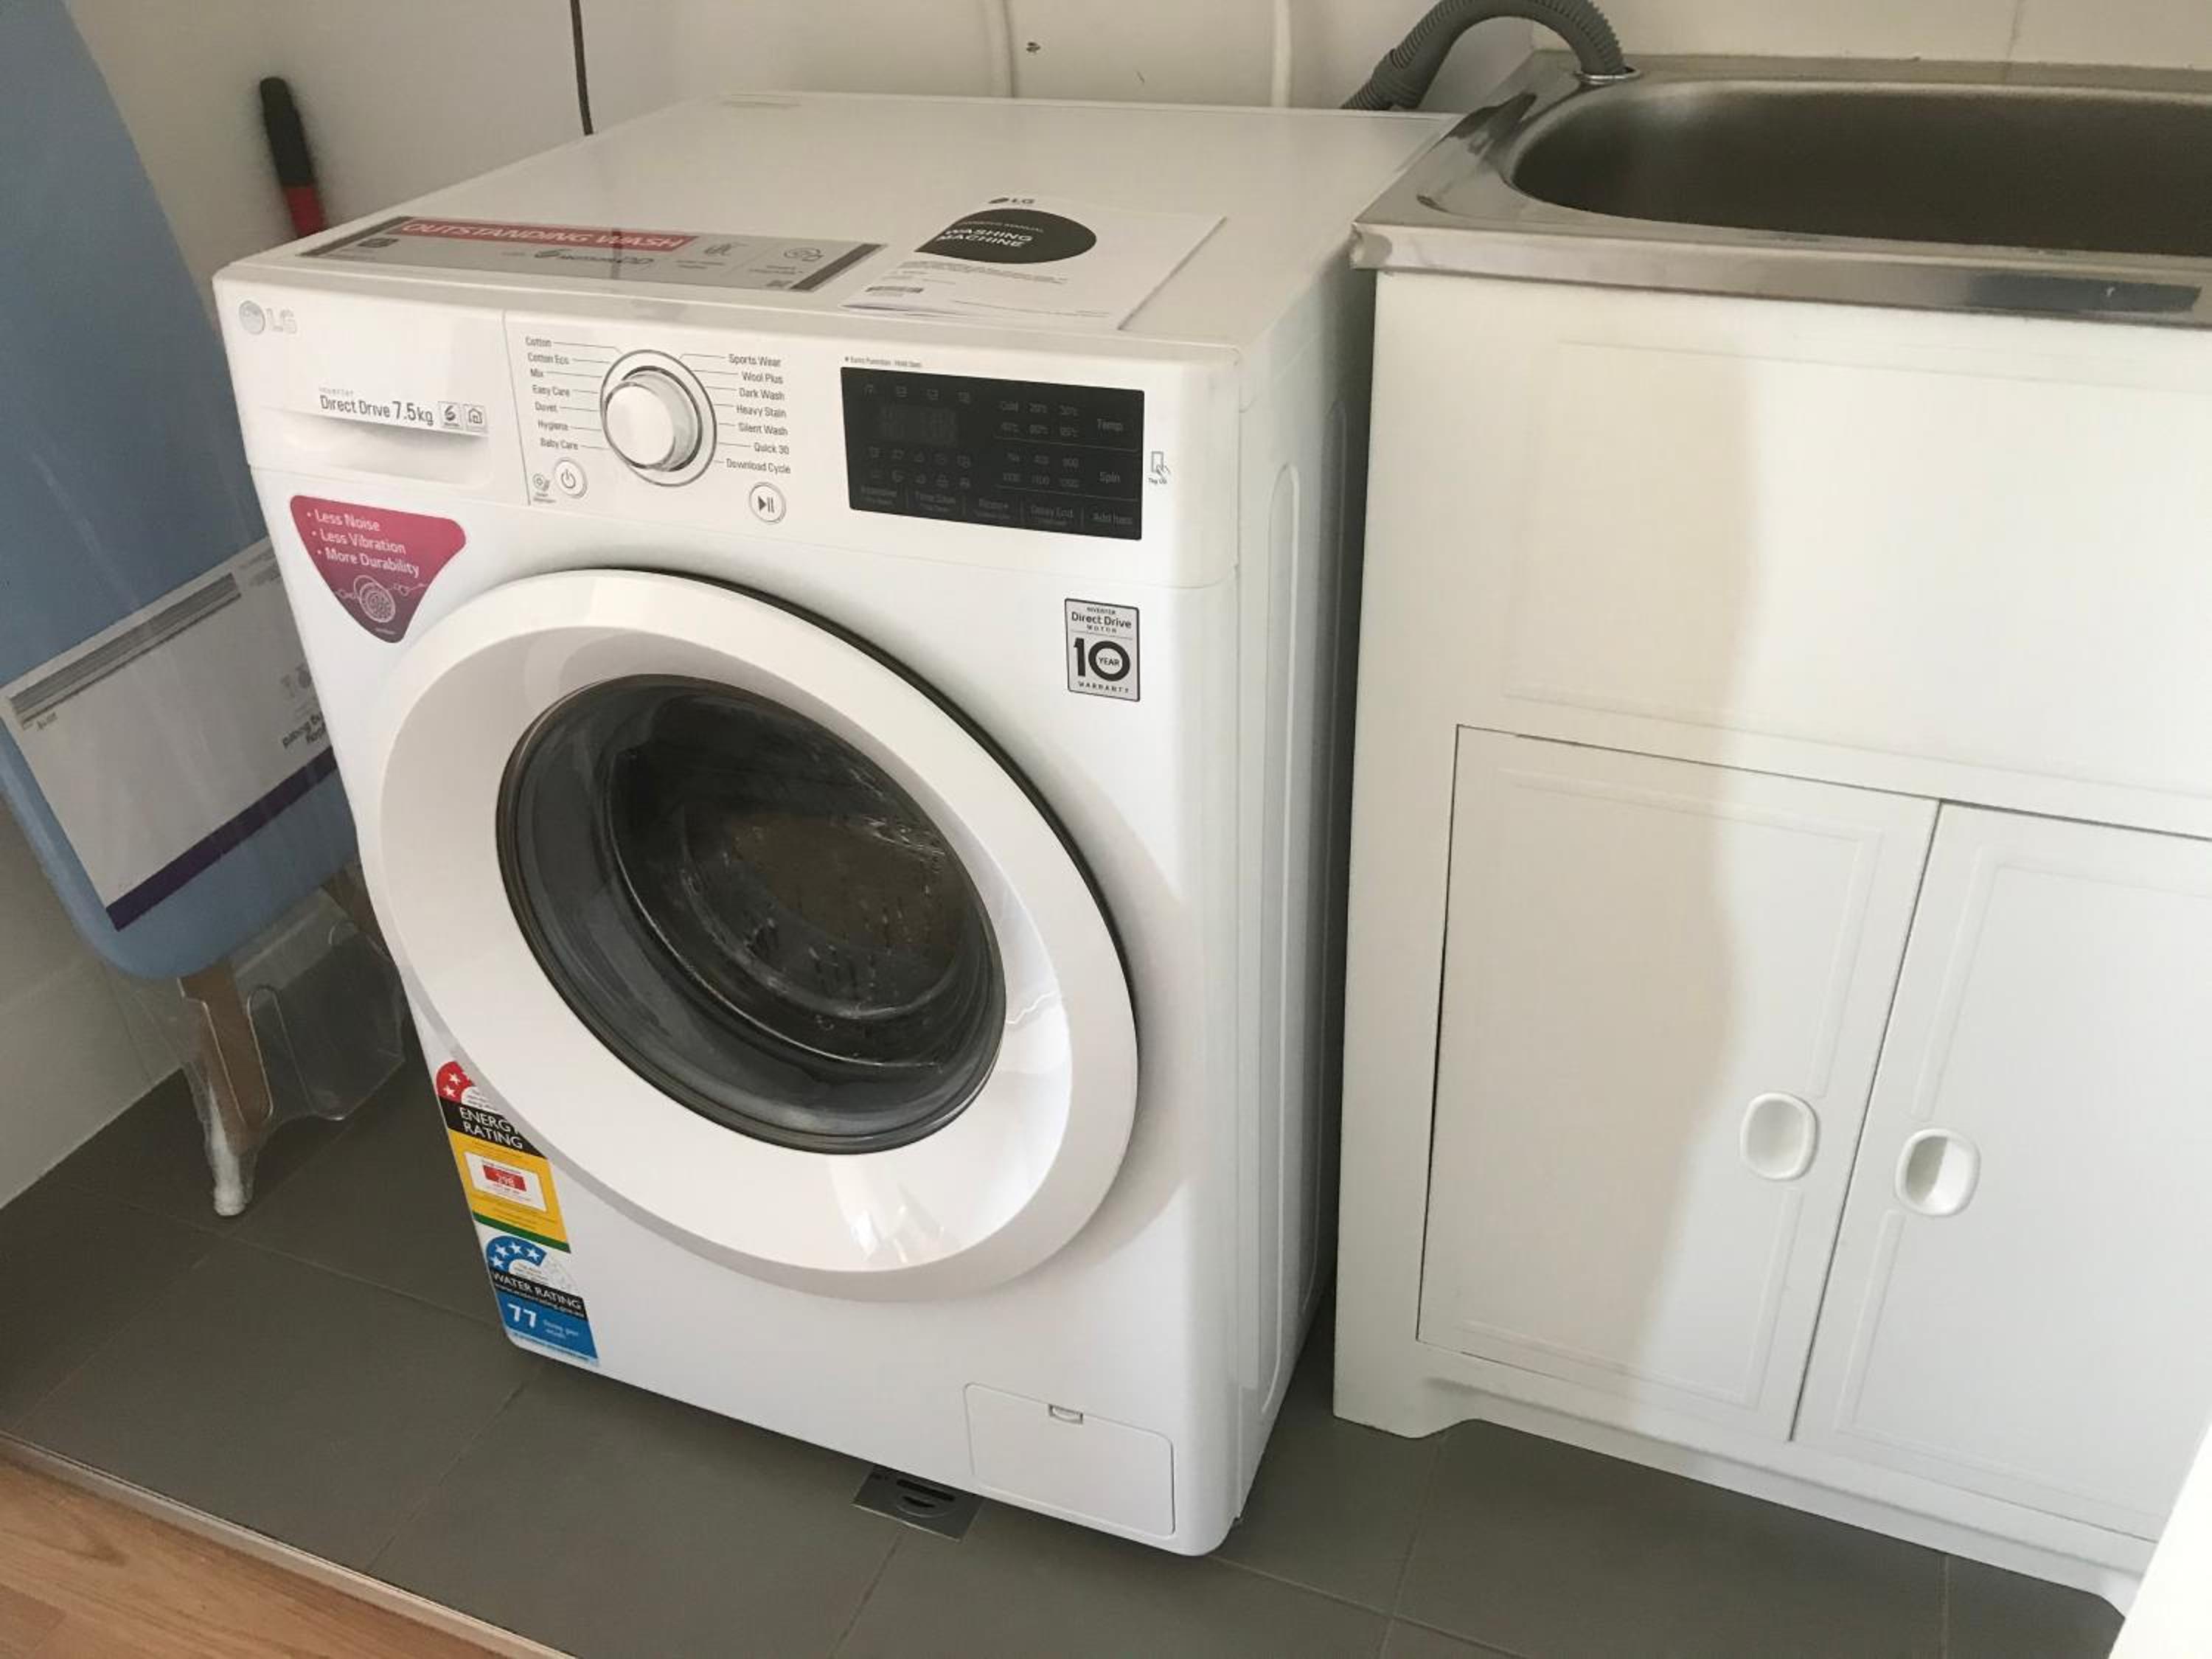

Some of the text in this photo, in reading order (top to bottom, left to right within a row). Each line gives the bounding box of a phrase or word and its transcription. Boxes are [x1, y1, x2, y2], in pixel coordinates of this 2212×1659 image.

[401, 222, 685, 251] OUTSTANDING WASH
[935, 235, 1028, 248] MACHINE
[945, 228, 1033, 243] WASHING
[526, 336, 552, 347] Cotton
[527, 352, 554, 364] Cotton
[728, 354, 782, 366] Sports Wear
[530, 369, 543, 378] Mix
[742, 371, 783, 383] Wool Plus
[532, 384, 570, 397] Easy Care
[739, 388, 785, 400] Dark Wash
[320, 394, 434, 427] Direct Drive 7.5kg
[535, 402, 557, 413] Duvet
[737, 405, 786, 418] Heavy Stain
[538, 420, 568, 432] Hygiene
[739, 422, 788, 436] Silent Wash
[540, 438, 579, 451] Baby Care
[754, 442, 790, 454] Quick 30
[726, 458, 791, 474] Download Cycle
[315, 509, 380, 532] Less Noise
[320, 528, 406, 555] Less Vibration
[325, 547, 420, 578] More Durability
[1071, 611, 1132, 629] Direct Drive
[1074, 637, 1130, 682] 10
[1099, 657, 1120, 666] YEAR
[1078, 681, 1130, 693] WARRANTY
[462, 1121, 524, 1150] RATING
[492, 1271, 533, 1293] WATER
[533, 1286, 582, 1310] RATING
[507, 1302, 538, 1329] 77
